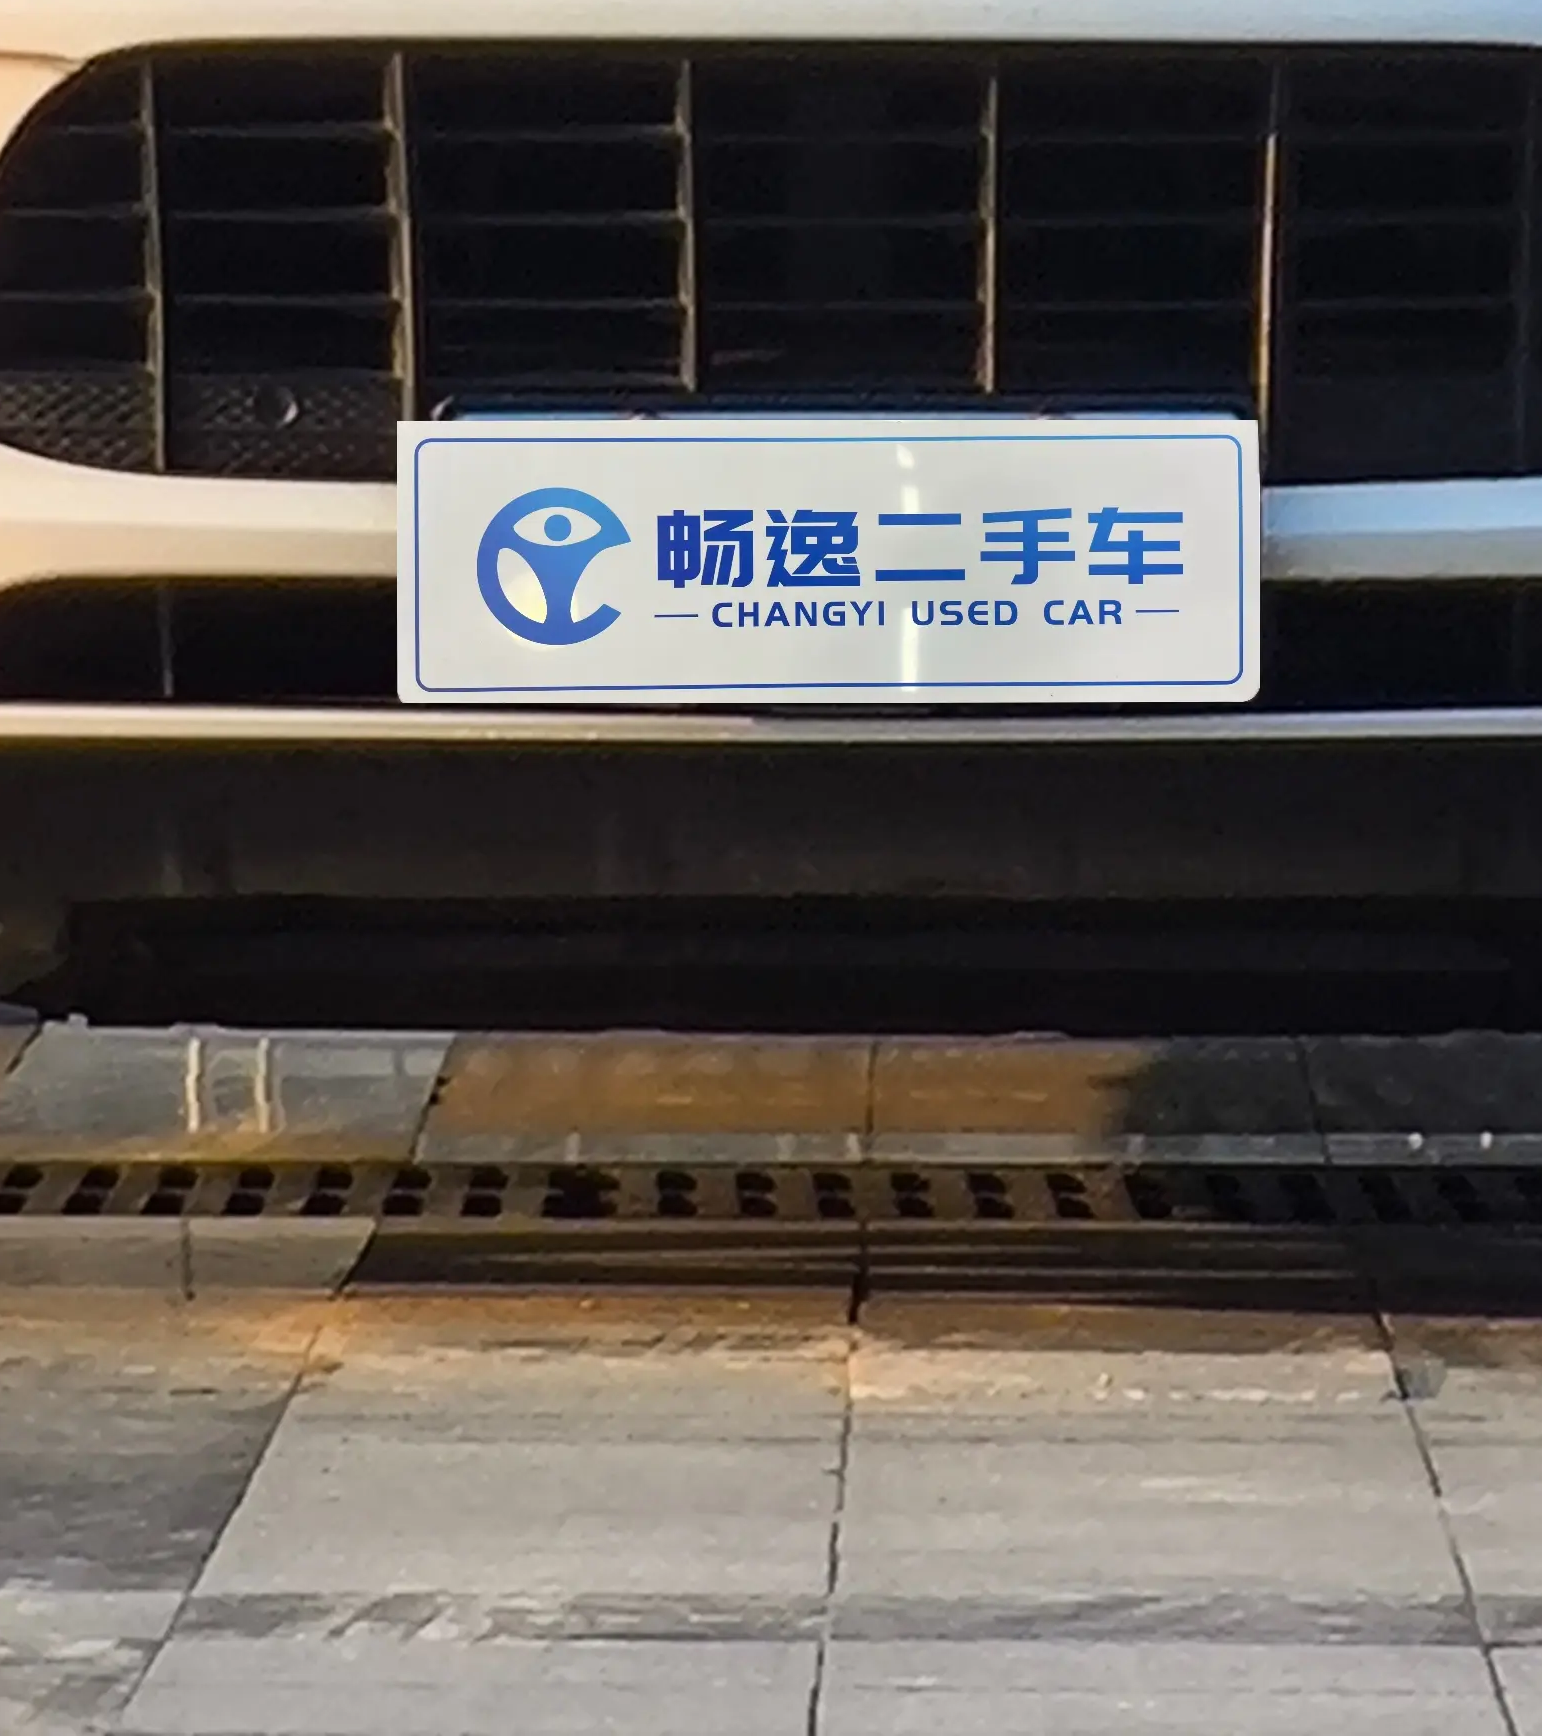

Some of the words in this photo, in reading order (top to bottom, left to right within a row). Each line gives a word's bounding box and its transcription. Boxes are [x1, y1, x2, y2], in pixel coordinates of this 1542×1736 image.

[656, 506, 1185, 589] 畅逸二手车
[712, 600, 885, 628] CHANGYI
[911, 599, 1018, 627] USED
[1043, 599, 1122, 626] CAR
